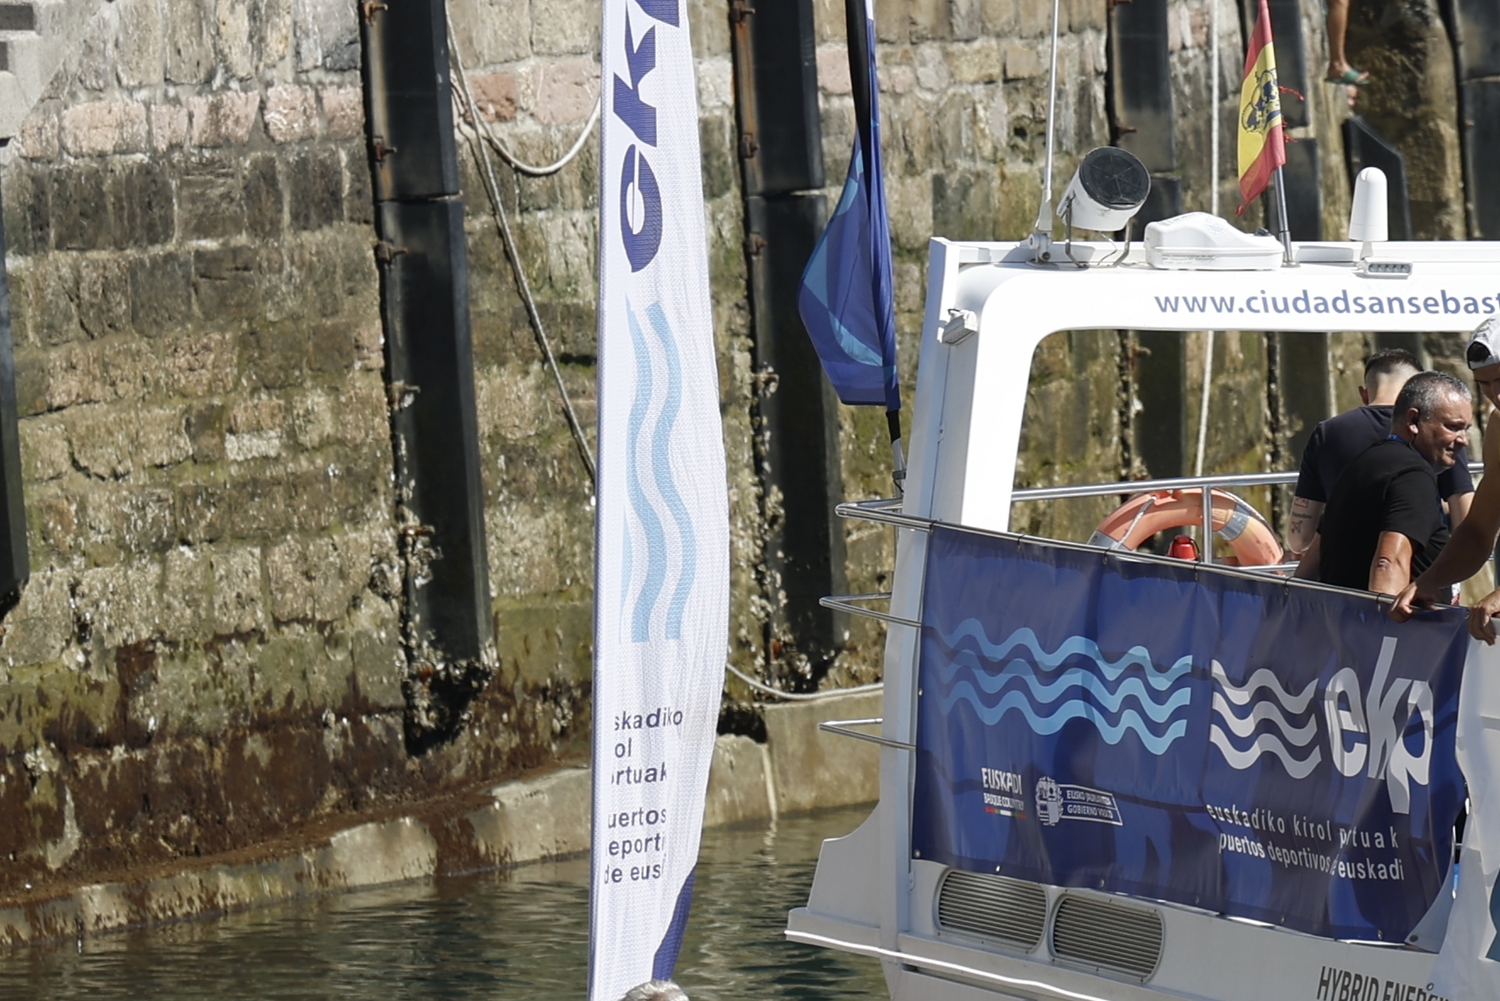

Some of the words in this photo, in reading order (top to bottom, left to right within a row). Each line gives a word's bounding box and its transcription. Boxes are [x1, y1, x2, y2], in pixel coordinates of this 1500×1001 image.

[1328, 636, 1435, 814] ekp
[981, 767, 1022, 795] EUSKADI
[1206, 804, 1285, 834] euskadiko
[1293, 814, 1332, 842] kirol
[1219, 832, 1266, 859] puertos
[1268, 841, 1331, 873] deportivos
[1338, 858, 1405, 881] euskadi
[1317, 966, 1379, 1001] HYBRID
